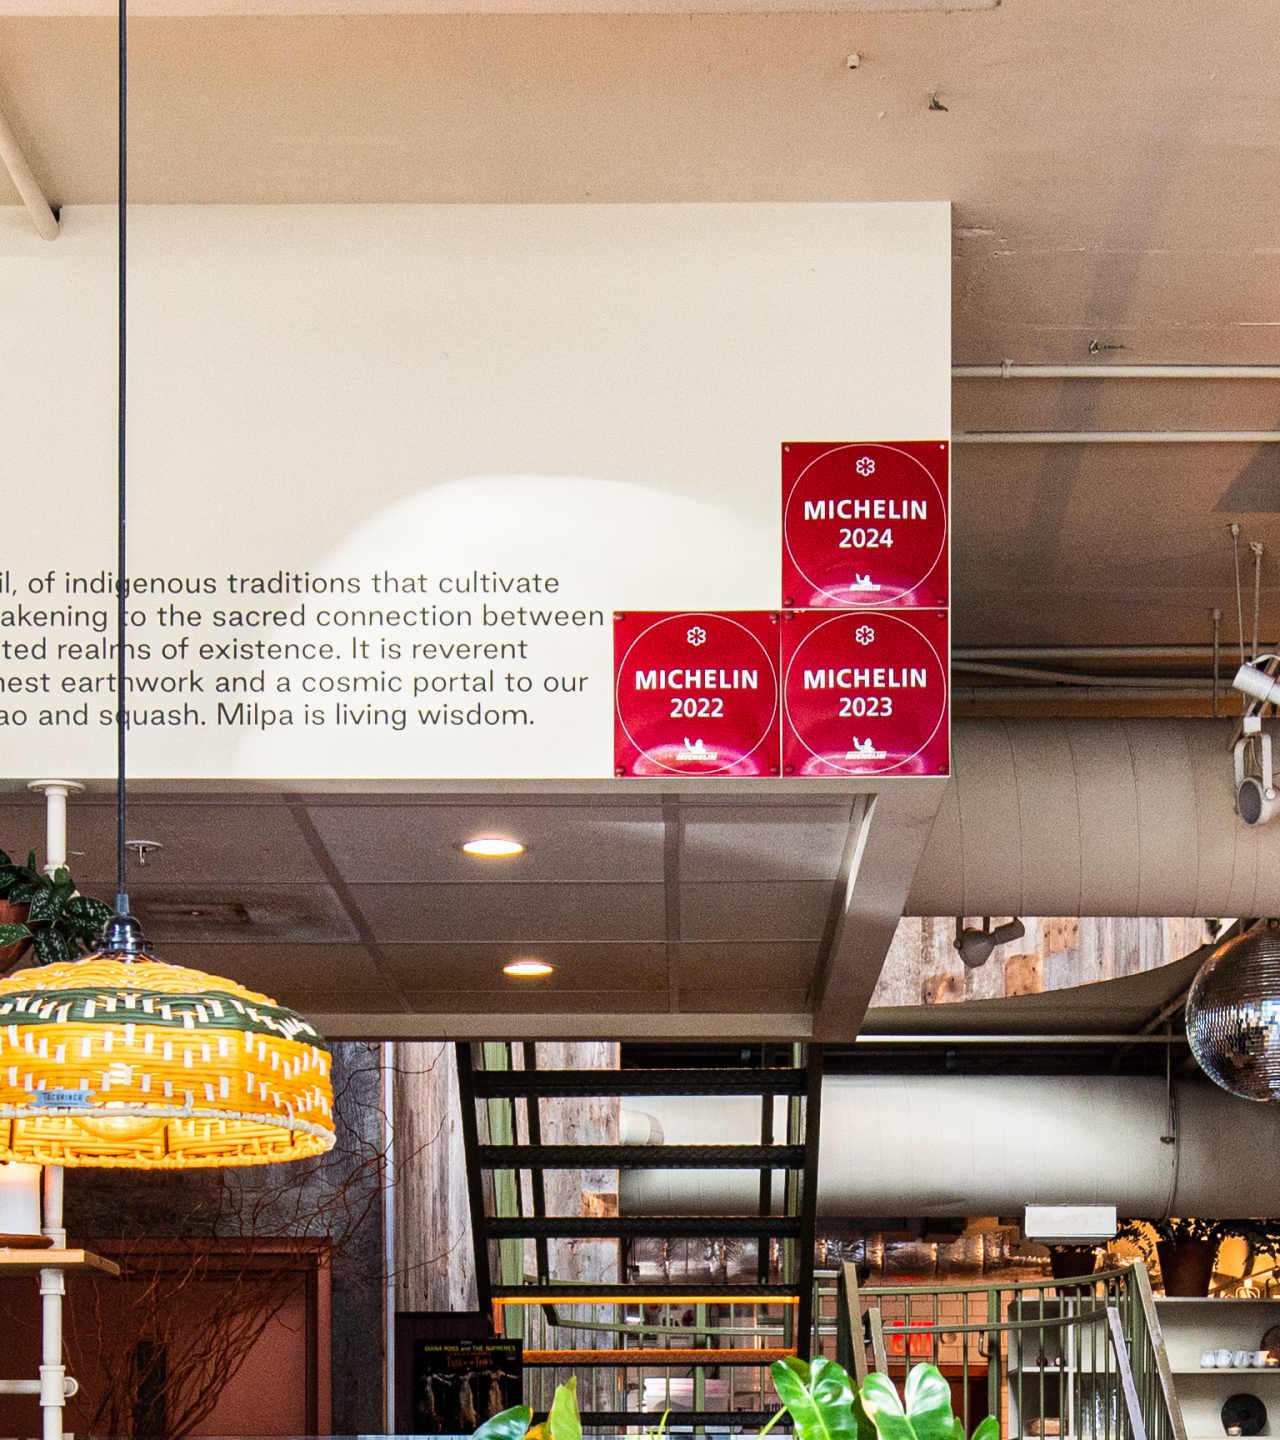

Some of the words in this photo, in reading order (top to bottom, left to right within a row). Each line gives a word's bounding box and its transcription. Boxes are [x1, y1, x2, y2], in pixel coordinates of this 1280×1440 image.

[803, 499, 927, 521] MICHELIN
[839, 528, 893, 548] 2024
[27, 569, 56, 595] of
[226, 569, 361, 595] traditions
[370, 569, 429, 594] that
[438, 569, 560, 594] cultivate
[156, 602, 203, 628] the
[212, 602, 306, 628] sacred
[315, 604, 472, 628] connection
[482, 602, 605, 628] between
[57, 635, 152, 661] realms
[161, 635, 190, 661] of
[198, 636, 341, 661] existence.
[352, 635, 371, 660] It
[380, 637, 402, 660] is
[412, 639, 529, 660] reverent
[215, 668, 265, 694] and
[275, 675, 292, 693] a
[301, 670, 403, 693] cosmic
[413, 668, 494, 699] portal
[504, 672, 533, 693] to
[543, 675, 590, 693] our
[635, 669, 758, 690] MICHELIN
[803, 668, 927, 689] MICHELIN
[38, 701, 89, 727] and
[217, 701, 295, 732] Milpa
[303, 703, 326, 726] is
[335, 701, 407, 732] living
[417, 701, 535, 726] wisdom.
[670, 698, 724, 718] 2022
[839, 697, 893, 717] 2023
